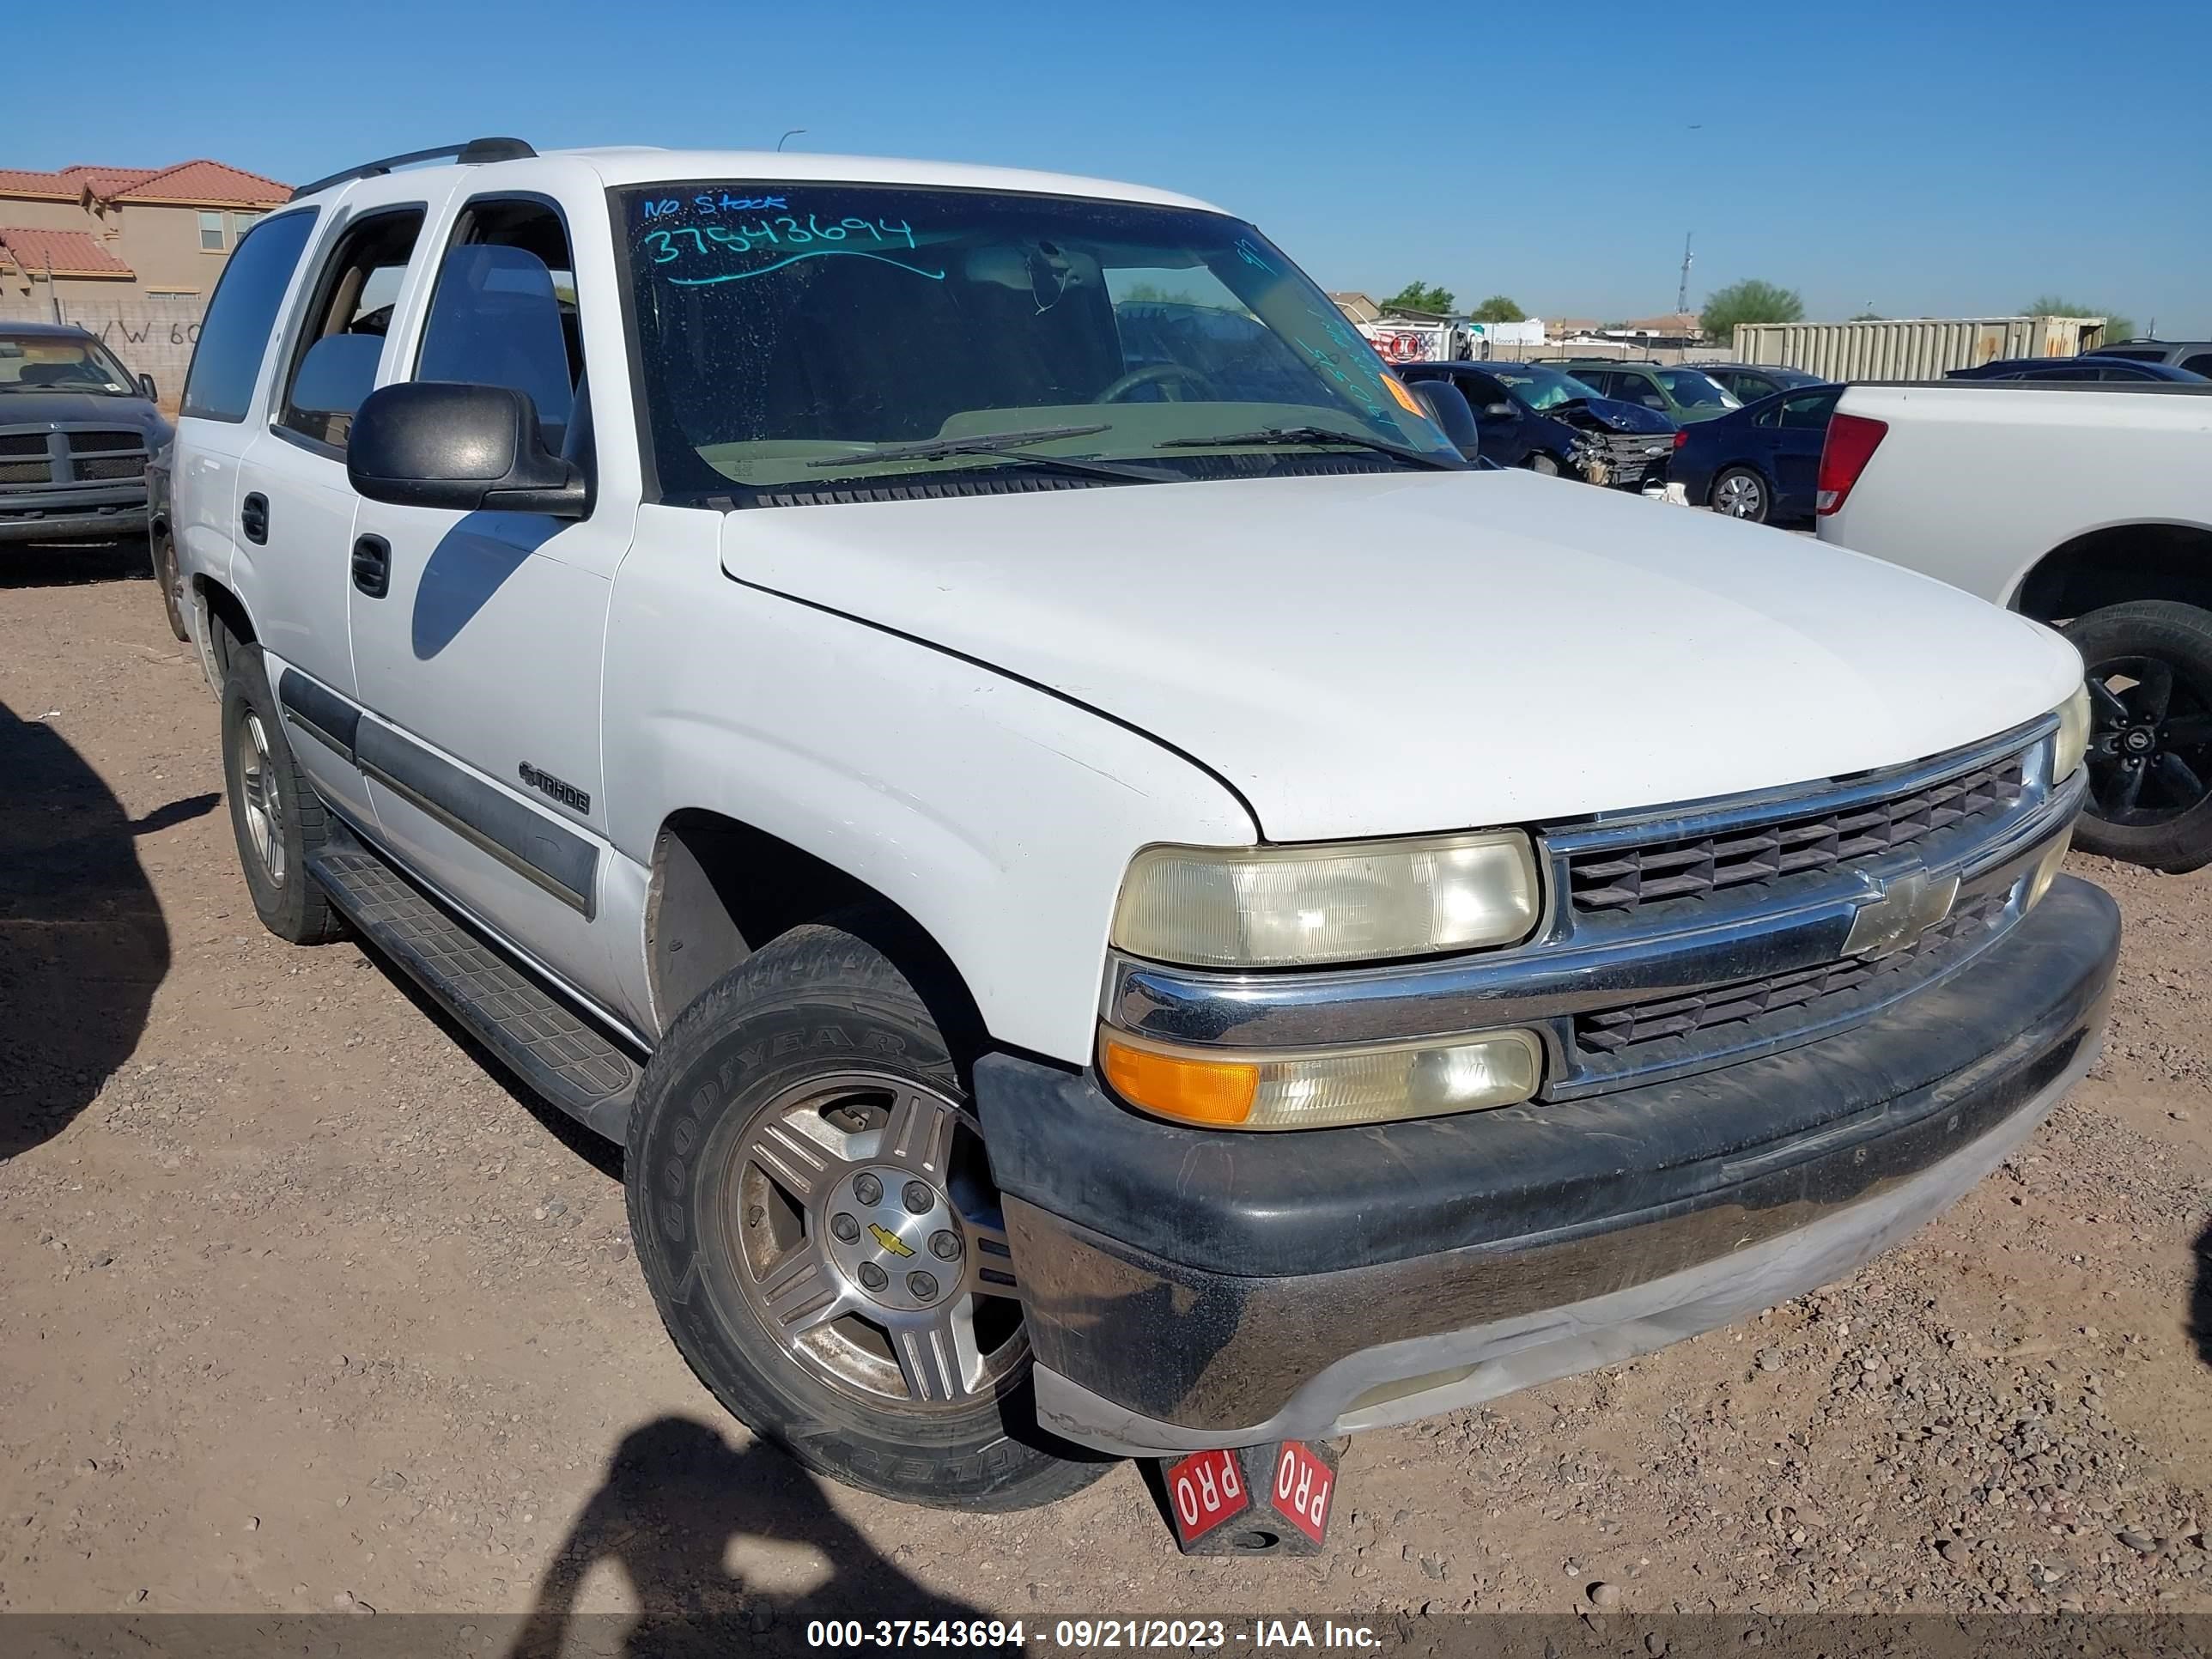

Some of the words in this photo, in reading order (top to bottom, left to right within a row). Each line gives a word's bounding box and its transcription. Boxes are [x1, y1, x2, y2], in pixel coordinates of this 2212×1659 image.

[645, 214, 916, 263] 37543694
[536, 769, 591, 816] TAHOE
[659, 1025, 907, 1243] GOODYEAR
[1177, 1449, 1240, 1526] PRO
[1279, 1449, 1328, 1528] PRO
